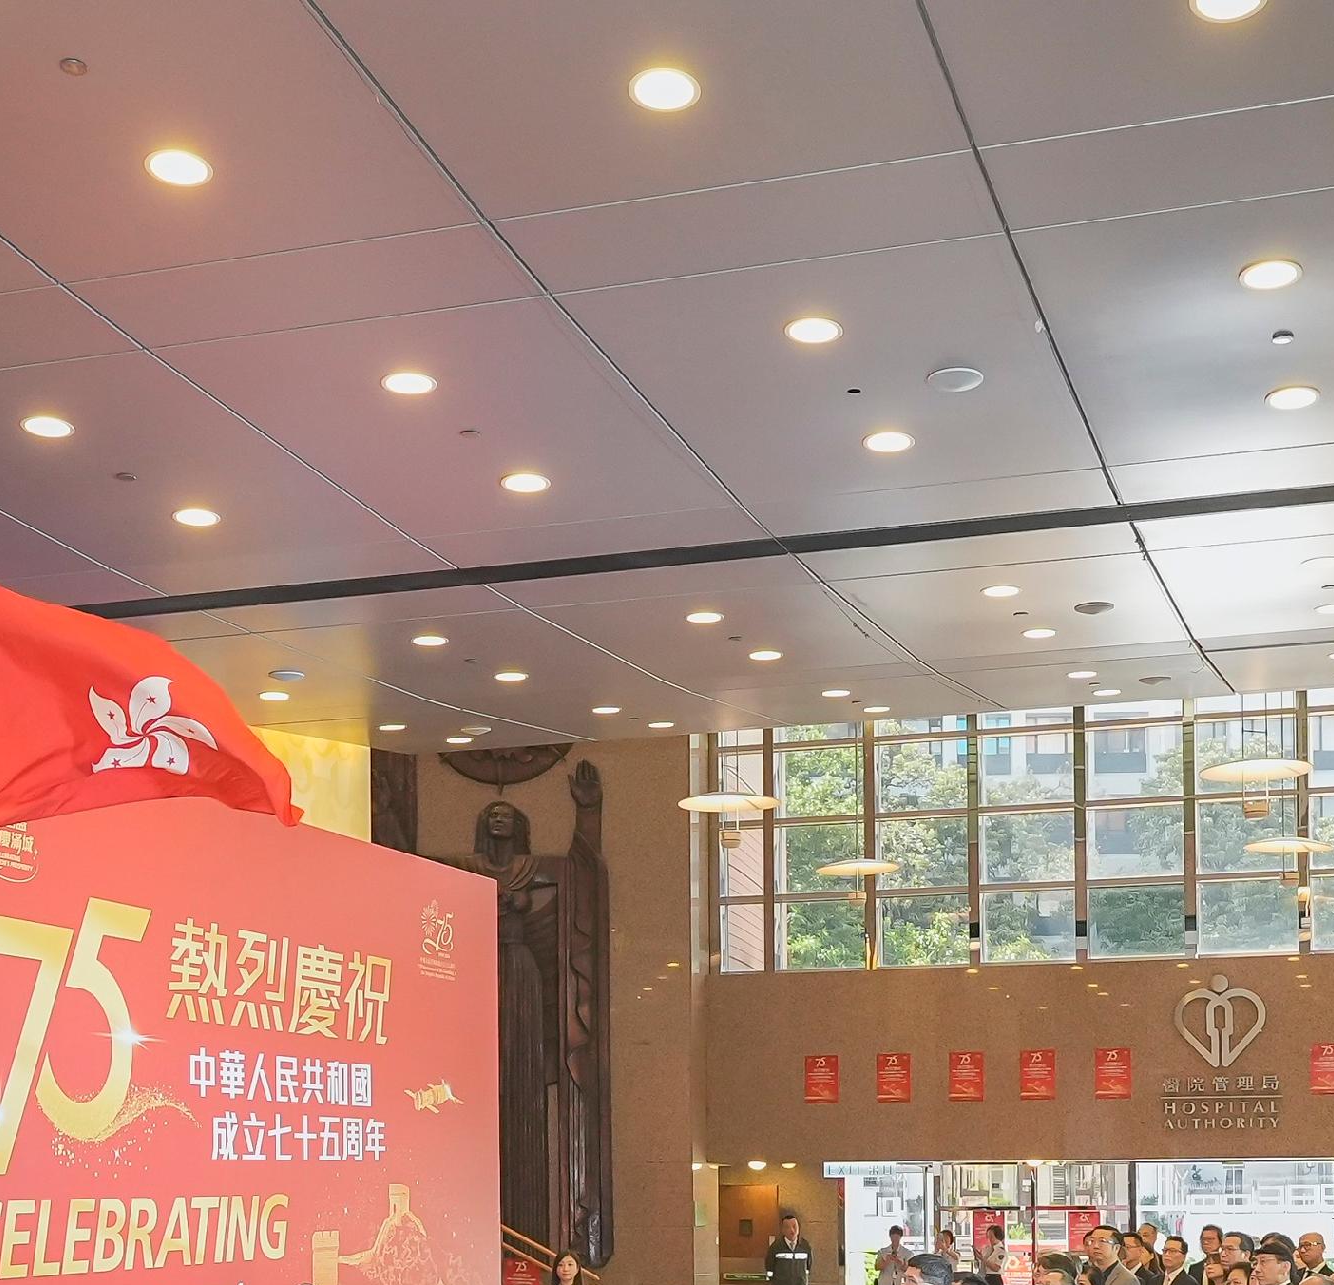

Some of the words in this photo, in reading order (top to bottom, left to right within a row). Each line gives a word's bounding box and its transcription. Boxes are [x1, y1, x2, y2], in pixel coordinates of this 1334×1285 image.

[166, 916, 393, 1046] 熱烈慶祝
[188, 1046, 373, 1108] 中華人民共和國
[1164, 1101, 1279, 1115] HOSPITAL
[1164, 1117, 1280, 1130] AUTHORITY
[211, 1112, 387, 1162] 成立七十五周年
[515, 1261, 528, 1273] 75
